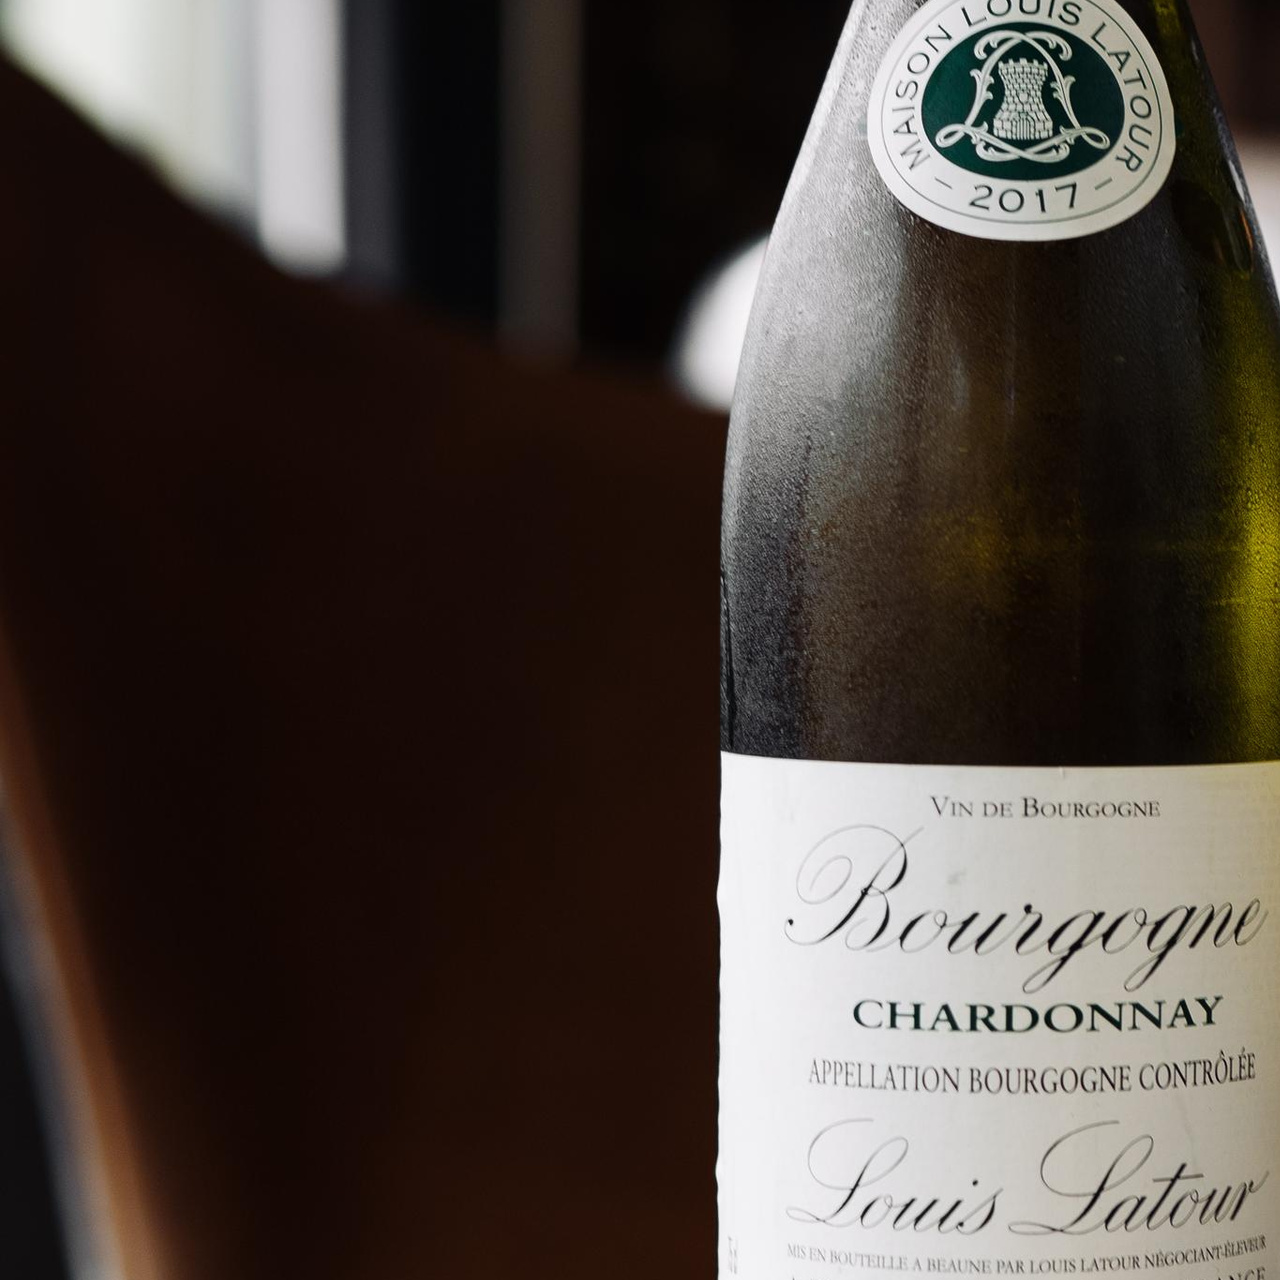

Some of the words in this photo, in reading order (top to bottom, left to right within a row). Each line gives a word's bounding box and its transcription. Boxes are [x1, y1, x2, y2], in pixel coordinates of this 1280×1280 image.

[892, 24, 953, 171] MAISON
[1090, 22, 1153, 173] LATOUR
[968, 182, 1079, 214] 2017
[783, 824, 1269, 995] Bourgogne
[852, 995, 1224, 1033] CHARDONNAY
[807, 1057, 961, 1094] APPELLATION
[968, 1064, 1132, 1095] BOURGOGNE
[1138, 1046, 1257, 1091] CONTRÔLÉE
[785, 1118, 1005, 1235] Louis
[1008, 1120, 1271, 1236] Latour
[787, 1243, 807, 1260] MIS
[809, 1247, 827, 1262] EN
[829, 1250, 909, 1271] BOUTEILLE
[912, 1259, 923, 1271] A
[927, 1258, 993, 1274] BEAUNE
[996, 1260, 1026, 1274] PAR
[1029, 1259, 1077, 1275] LOUIS
[1080, 1256, 1141, 1273] LATOUR
